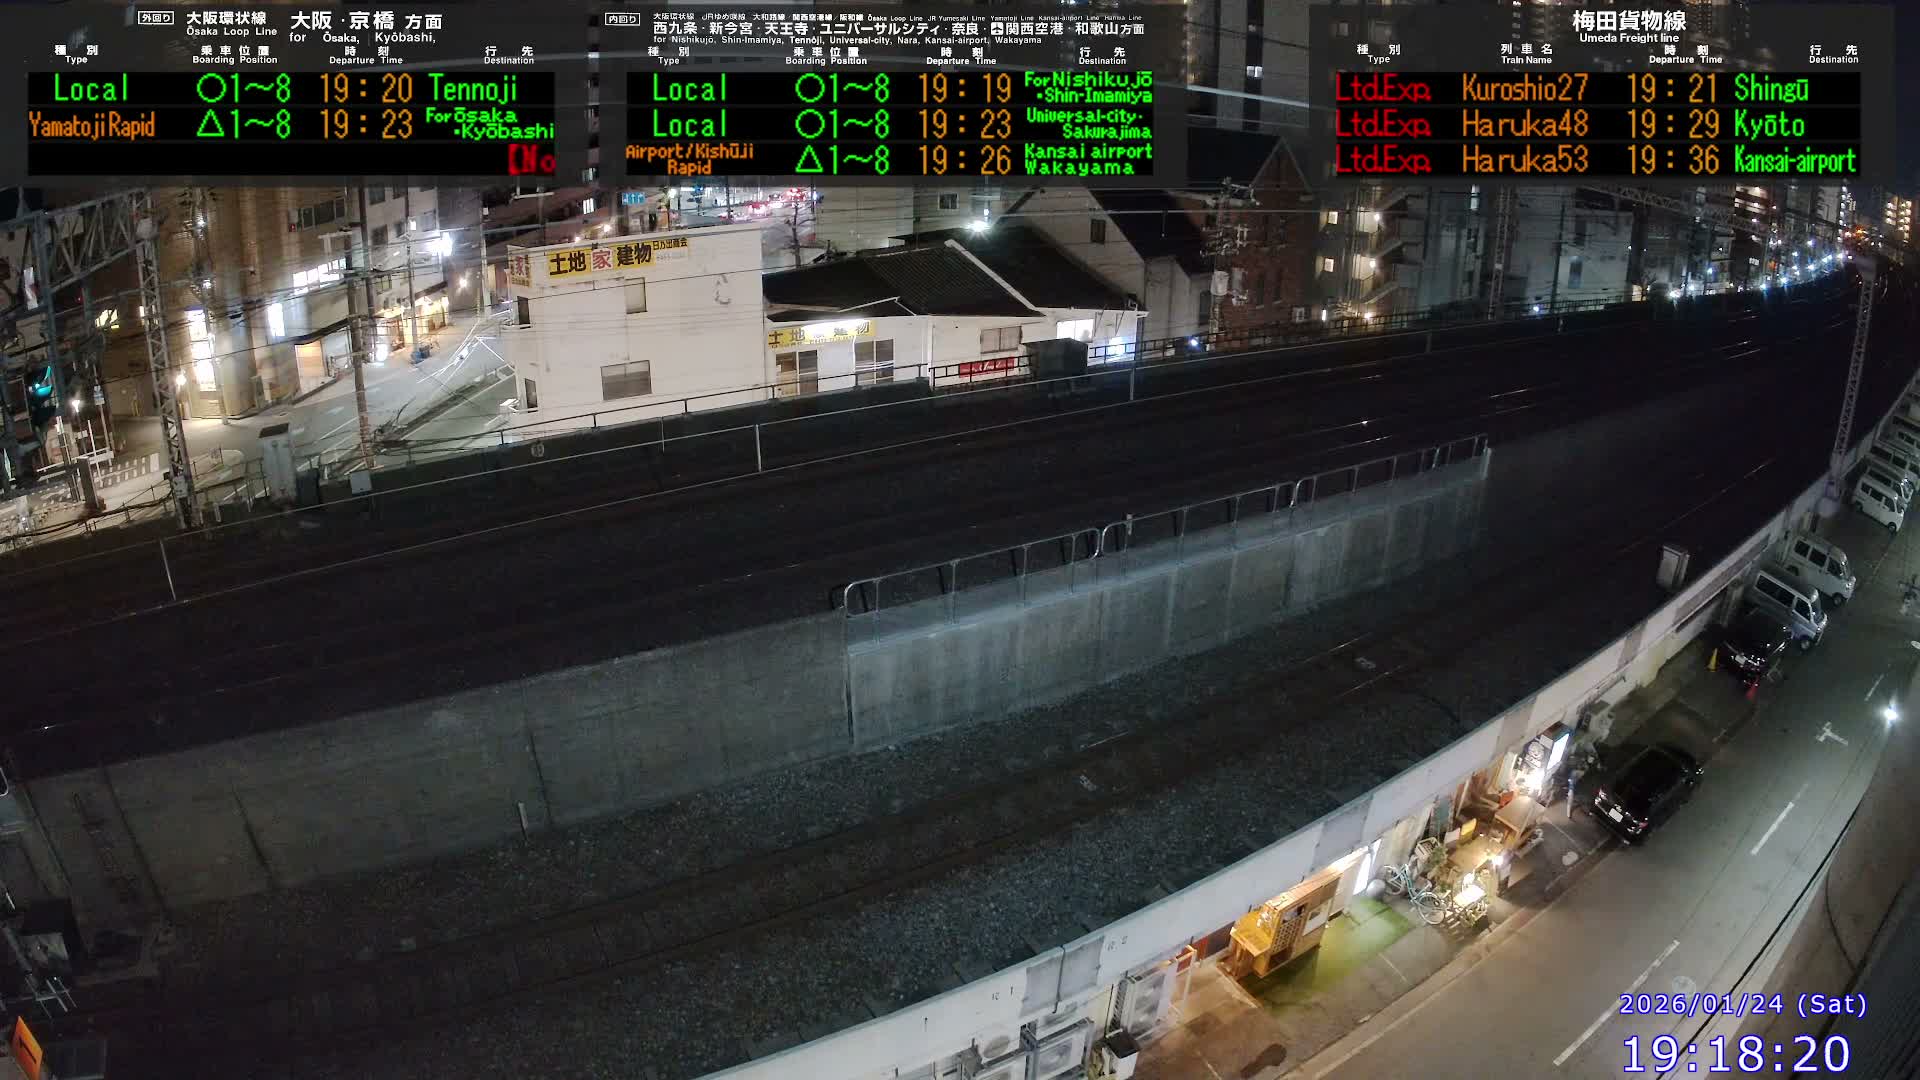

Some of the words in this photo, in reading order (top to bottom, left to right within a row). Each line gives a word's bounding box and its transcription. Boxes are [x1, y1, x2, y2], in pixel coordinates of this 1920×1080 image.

[549, 243, 652, 276] 土地家建物
[768, 321, 870, 346] 土地建物
